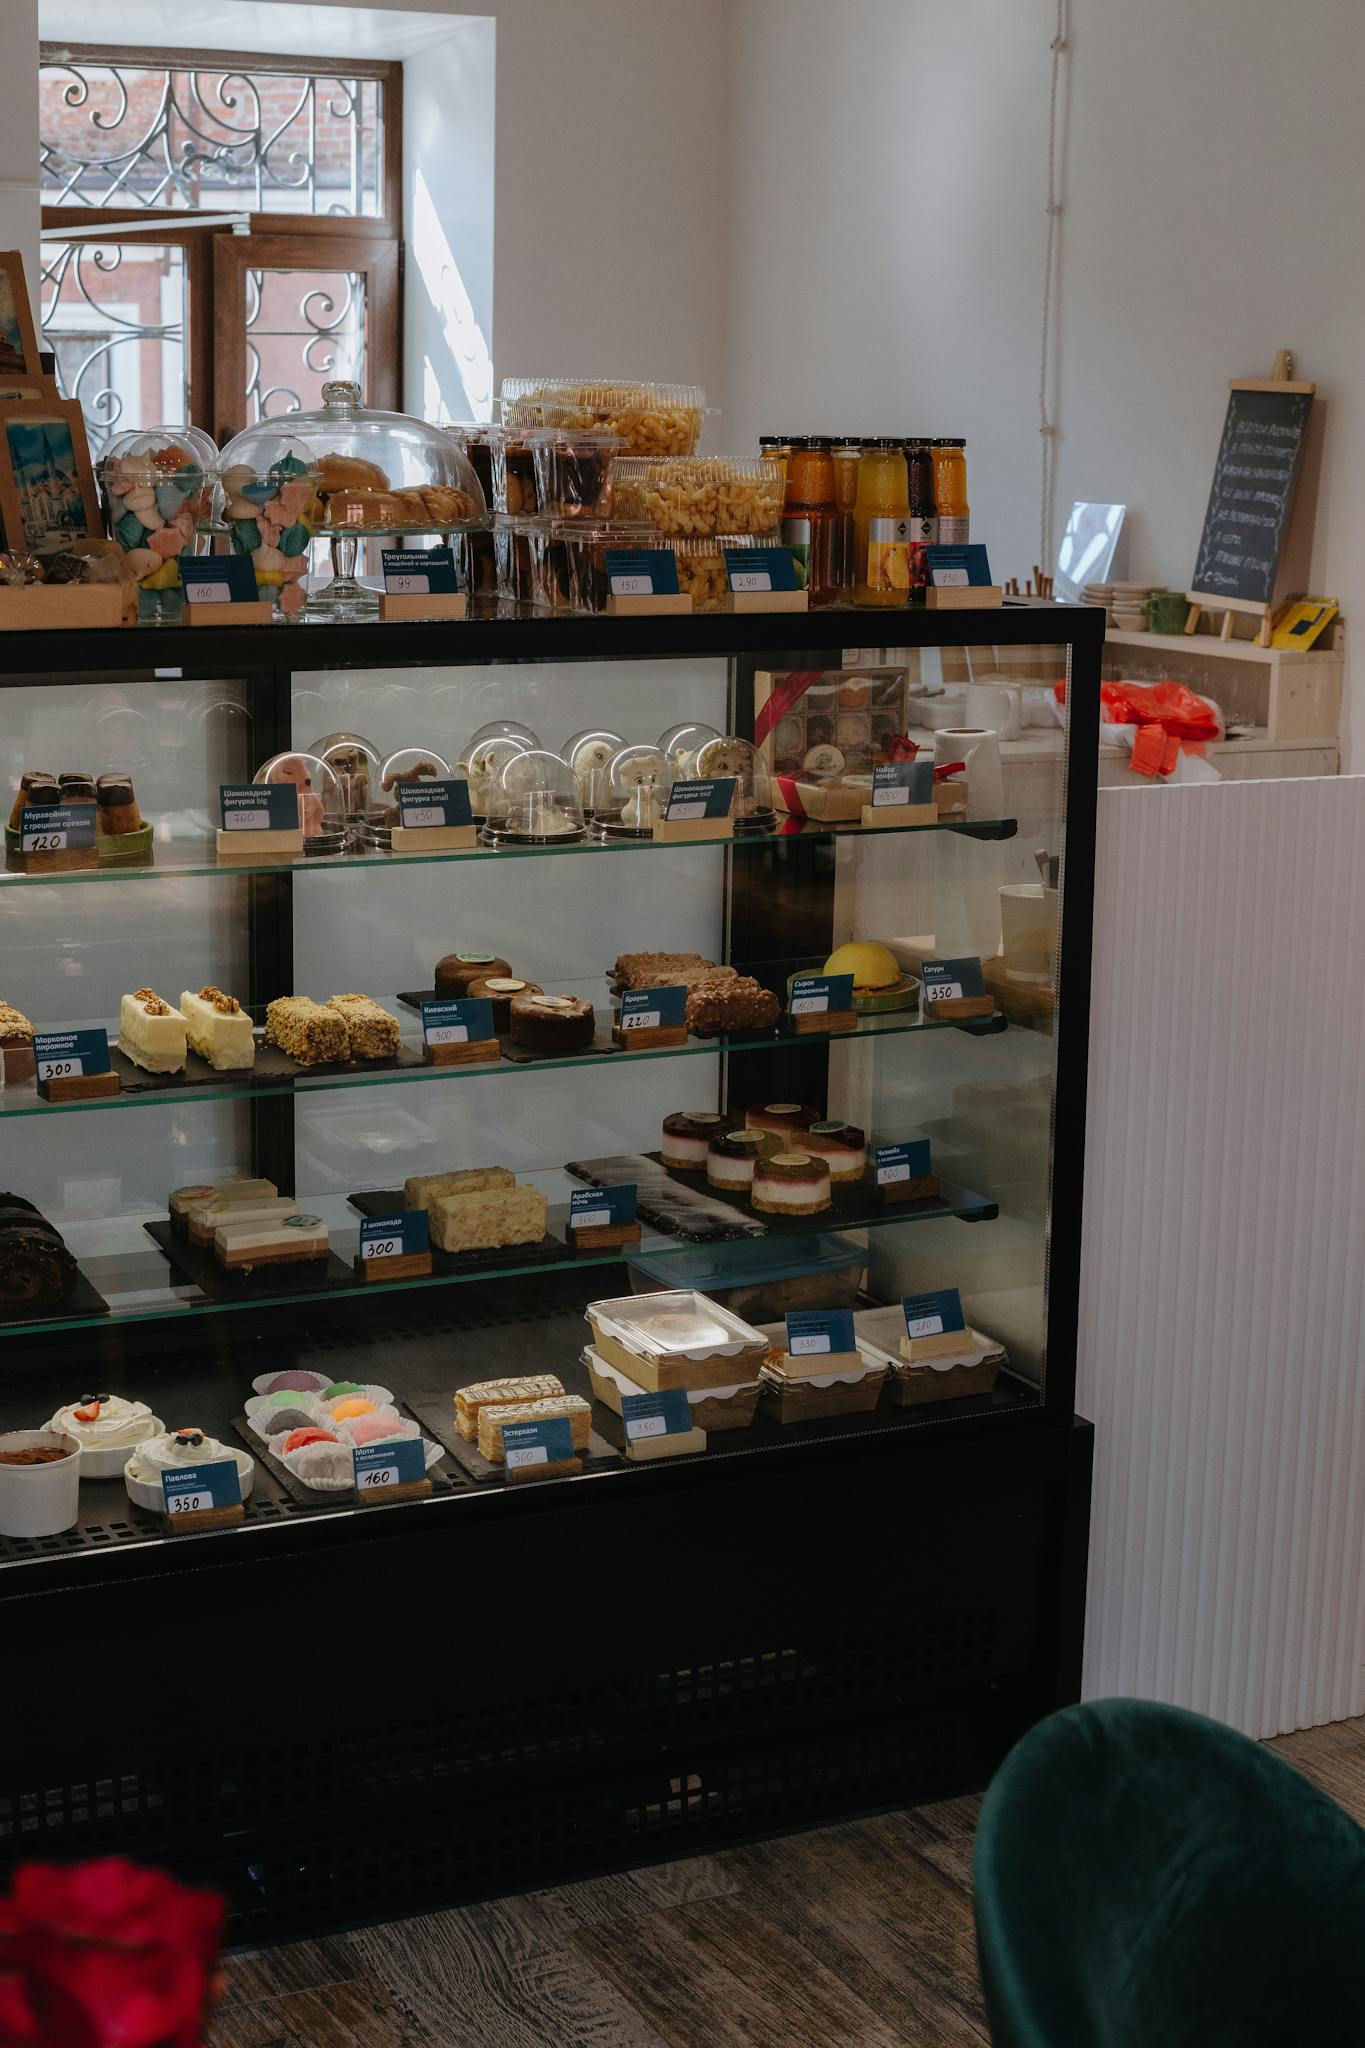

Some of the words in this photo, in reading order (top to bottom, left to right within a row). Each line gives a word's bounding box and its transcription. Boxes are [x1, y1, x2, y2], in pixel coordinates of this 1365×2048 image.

[383, 553, 429, 561] Треугольник
[398, 577, 411, 589] 99
[621, 580, 638, 591] 150
[738, 576, 757, 587] 290
[197, 587, 213, 598] 150
[875, 772, 898, 780] конфет
[223, 790, 272, 798] Шоколадная
[400, 787, 446, 795] Шоколадная
[674, 784, 715, 793] Шоколадная
[401, 795, 431, 804] фигурка
[431, 794, 449, 802] small
[672, 792, 699, 800] фигурка
[224, 798, 256, 807] фигурка
[256, 797, 268, 806] big
[24, 809, 72, 820] Муравейник
[234, 812, 255, 824] 700
[29, 822, 61, 831] грецким
[62, 819, 91, 828] орехом
[31, 835, 61, 851] 120
[794, 980, 815, 988] Сырок
[793, 985, 830, 996] творожный
[931, 986, 953, 1000] 350
[625, 994, 649, 1003] Брауни
[424, 1004, 458, 1013] Киевский
[627, 1015, 650, 1028] 220
[35, 1034, 78, 1044] Морковное
[435, 1030, 452, 1041] 300
[36, 1042, 75, 1051] пирожное
[46, 1063, 71, 1079] 300
[572, 1191, 604, 1200] Арабская
[368, 1218, 402, 1229] шоколада
[576, 1214, 596, 1225] 300
[367, 1241, 394, 1257] 300
[503, 1427, 538, 1437] Эстерхази
[355, 1448, 375, 1456] Моти
[165, 1473, 197, 1483] Павлова
[364, 1470, 390, 1486] 160
[174, 1496, 200, 1513] 350
